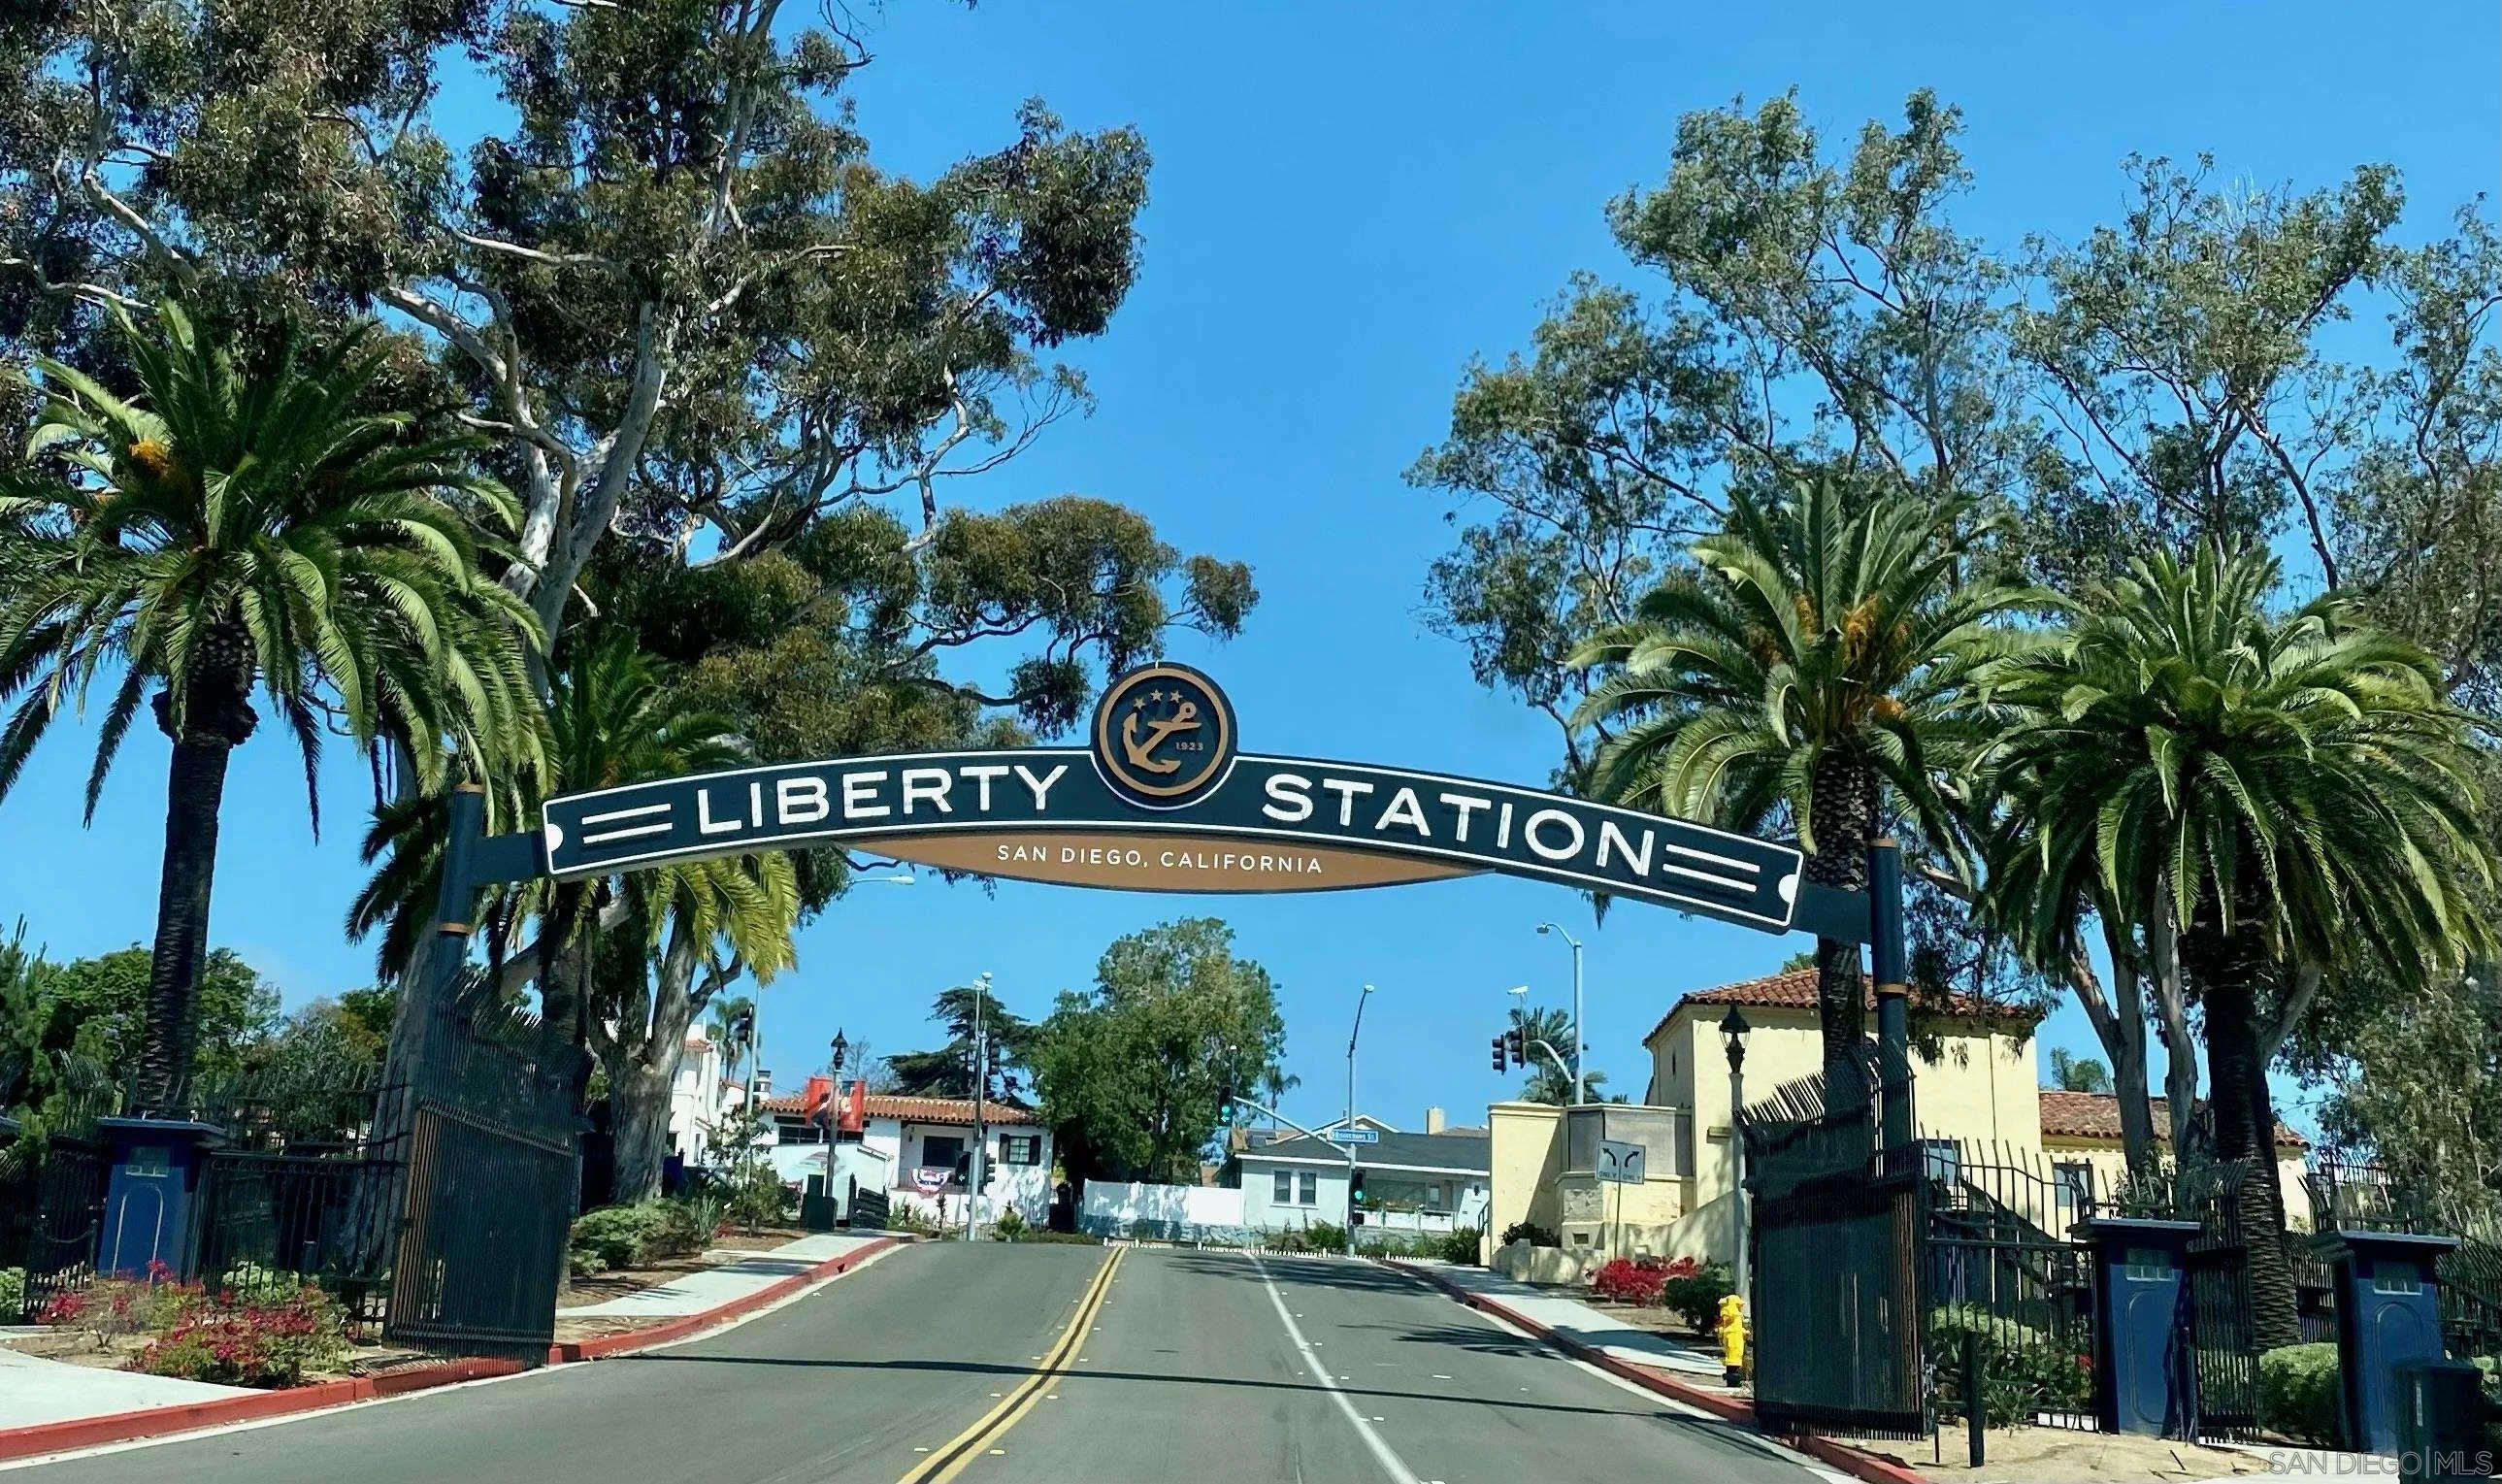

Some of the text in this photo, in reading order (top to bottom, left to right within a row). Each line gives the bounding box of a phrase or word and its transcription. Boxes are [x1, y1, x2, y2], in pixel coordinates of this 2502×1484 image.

[1174, 742, 1204, 752] 1923
[697, 765, 1654, 877] LIBERTY STATION
[997, 844, 1323, 874] SAN DIEGO, CALIFORNIA
